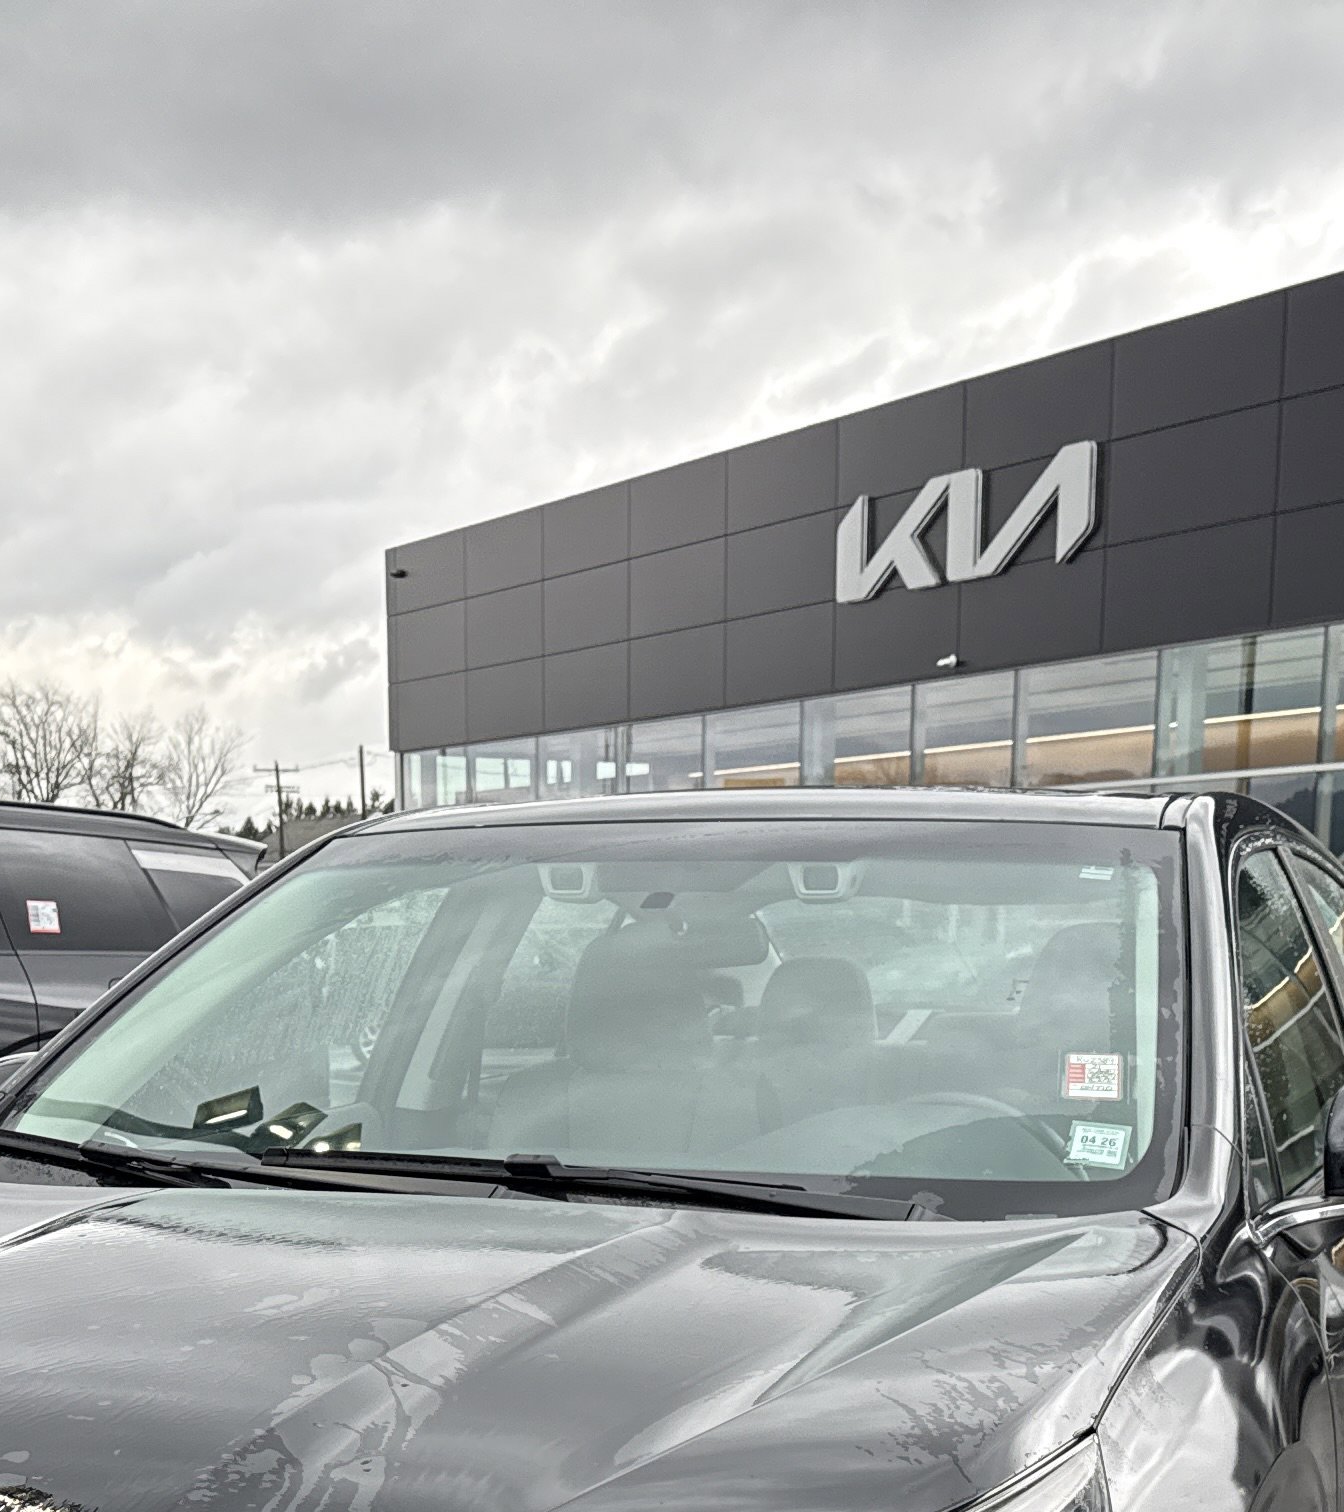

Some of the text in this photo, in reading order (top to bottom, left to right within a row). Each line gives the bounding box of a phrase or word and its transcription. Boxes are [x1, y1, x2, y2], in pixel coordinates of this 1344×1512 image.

[836, 440, 1097, 603] KIA
[1080, 1135, 1117, 1147] 04 26
